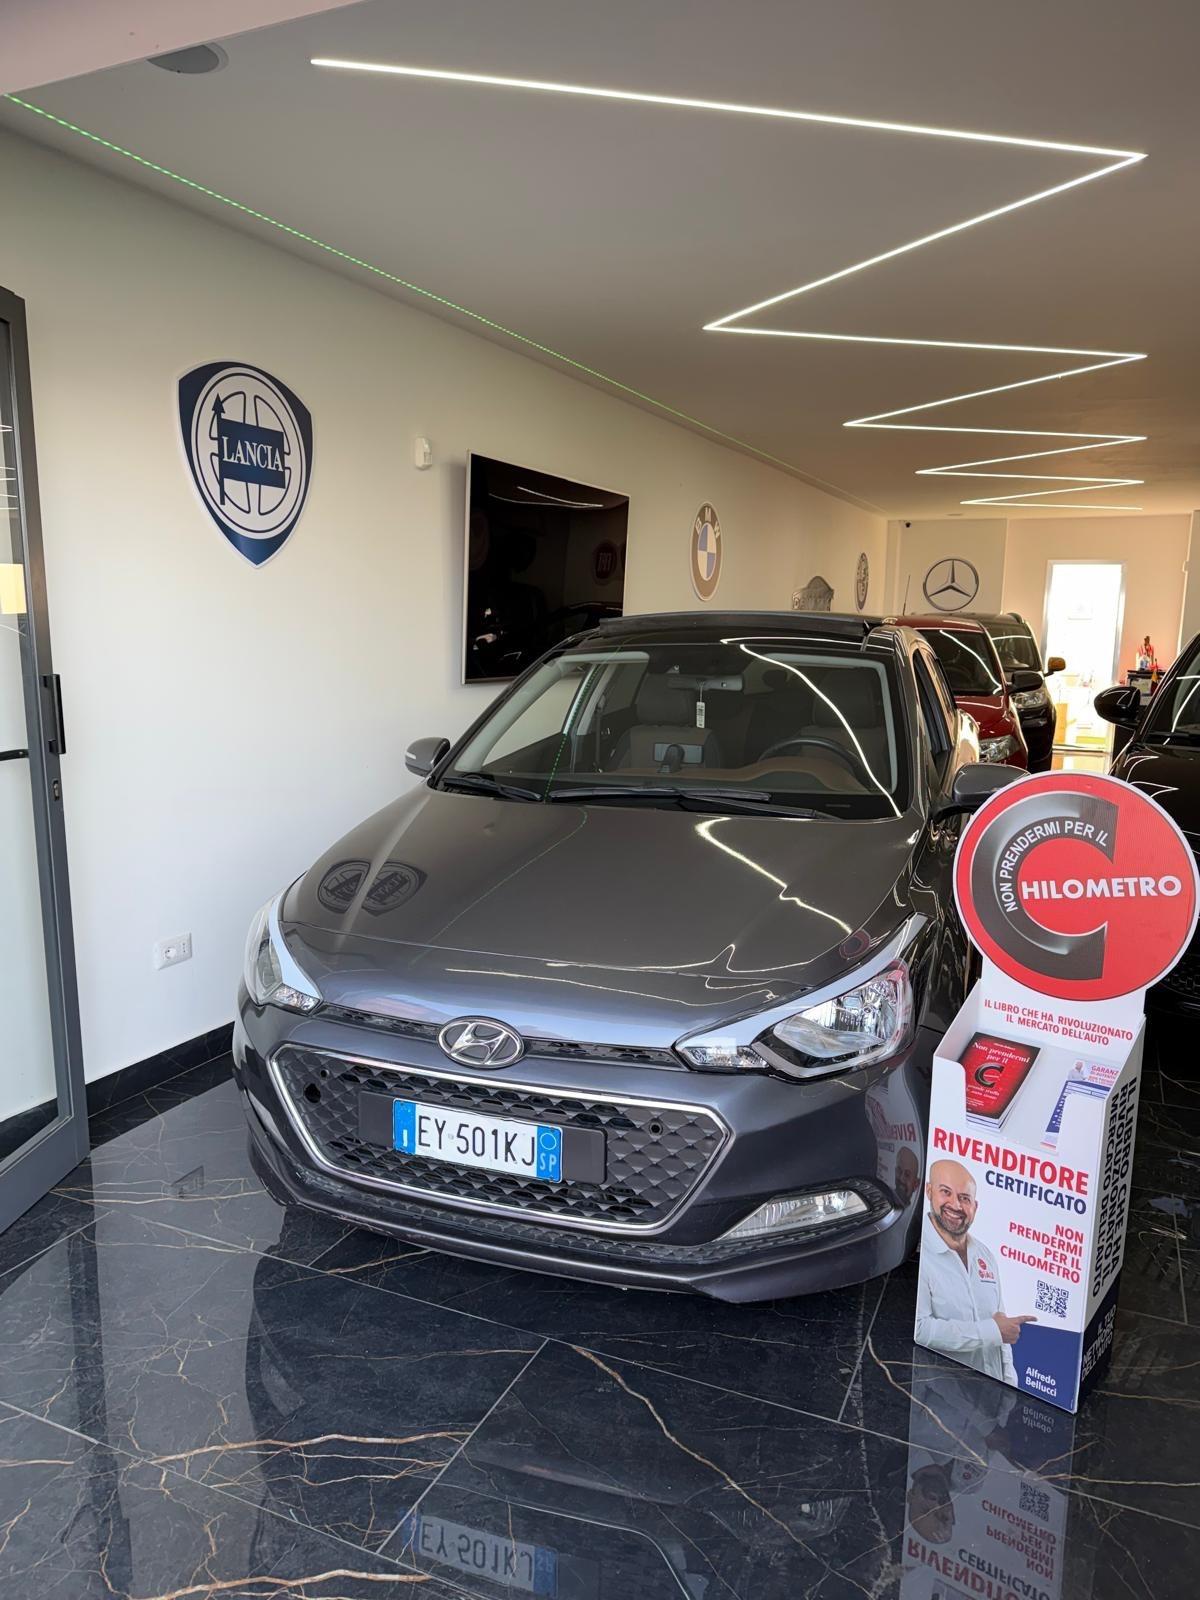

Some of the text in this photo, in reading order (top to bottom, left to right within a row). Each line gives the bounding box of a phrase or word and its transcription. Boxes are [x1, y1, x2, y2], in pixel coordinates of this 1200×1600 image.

[222, 436, 284, 472] LANCIA
[695, 506, 721, 539] BMW
[1000, 820, 1108, 913] NON PRENDERMI PER IL
[984, 999, 1133, 1041] IL LIBRO CHE HA RIVOLUZIONATO
[1006, 1013, 1110, 1046] IL MERCATO DELL'AUTO
[973, 1042, 988, 1052] Non
[988, 1047, 1031, 1063] prendermi
[986, 1054, 1001, 1062] per
[418, 1115, 536, 1167] EY 501KJ
[1103, 1092, 1120, 1190] MERCATO
[540, 1152, 557, 1173] SP
[933, 1127, 1089, 1196] RIVENDITORE
[1110, 1076, 1138, 1275] IL LIBRO CHE HA
[985, 1170, 1087, 1215] CERTIFICATO
[1101, 1083, 1129, 1288] RIVOLUZIONATO IL
[1009, 1221, 1083, 1258] PRENDERMI
[1055, 1224, 1084, 1245] NON
[1000, 1245, 1081, 1284] CHILOMETRO
[1044, 1247, 1082, 1272] PER IL
[1025, 1366, 1056, 1387] Alfredo
[1025, 1376, 1058, 1397] Bellucci
